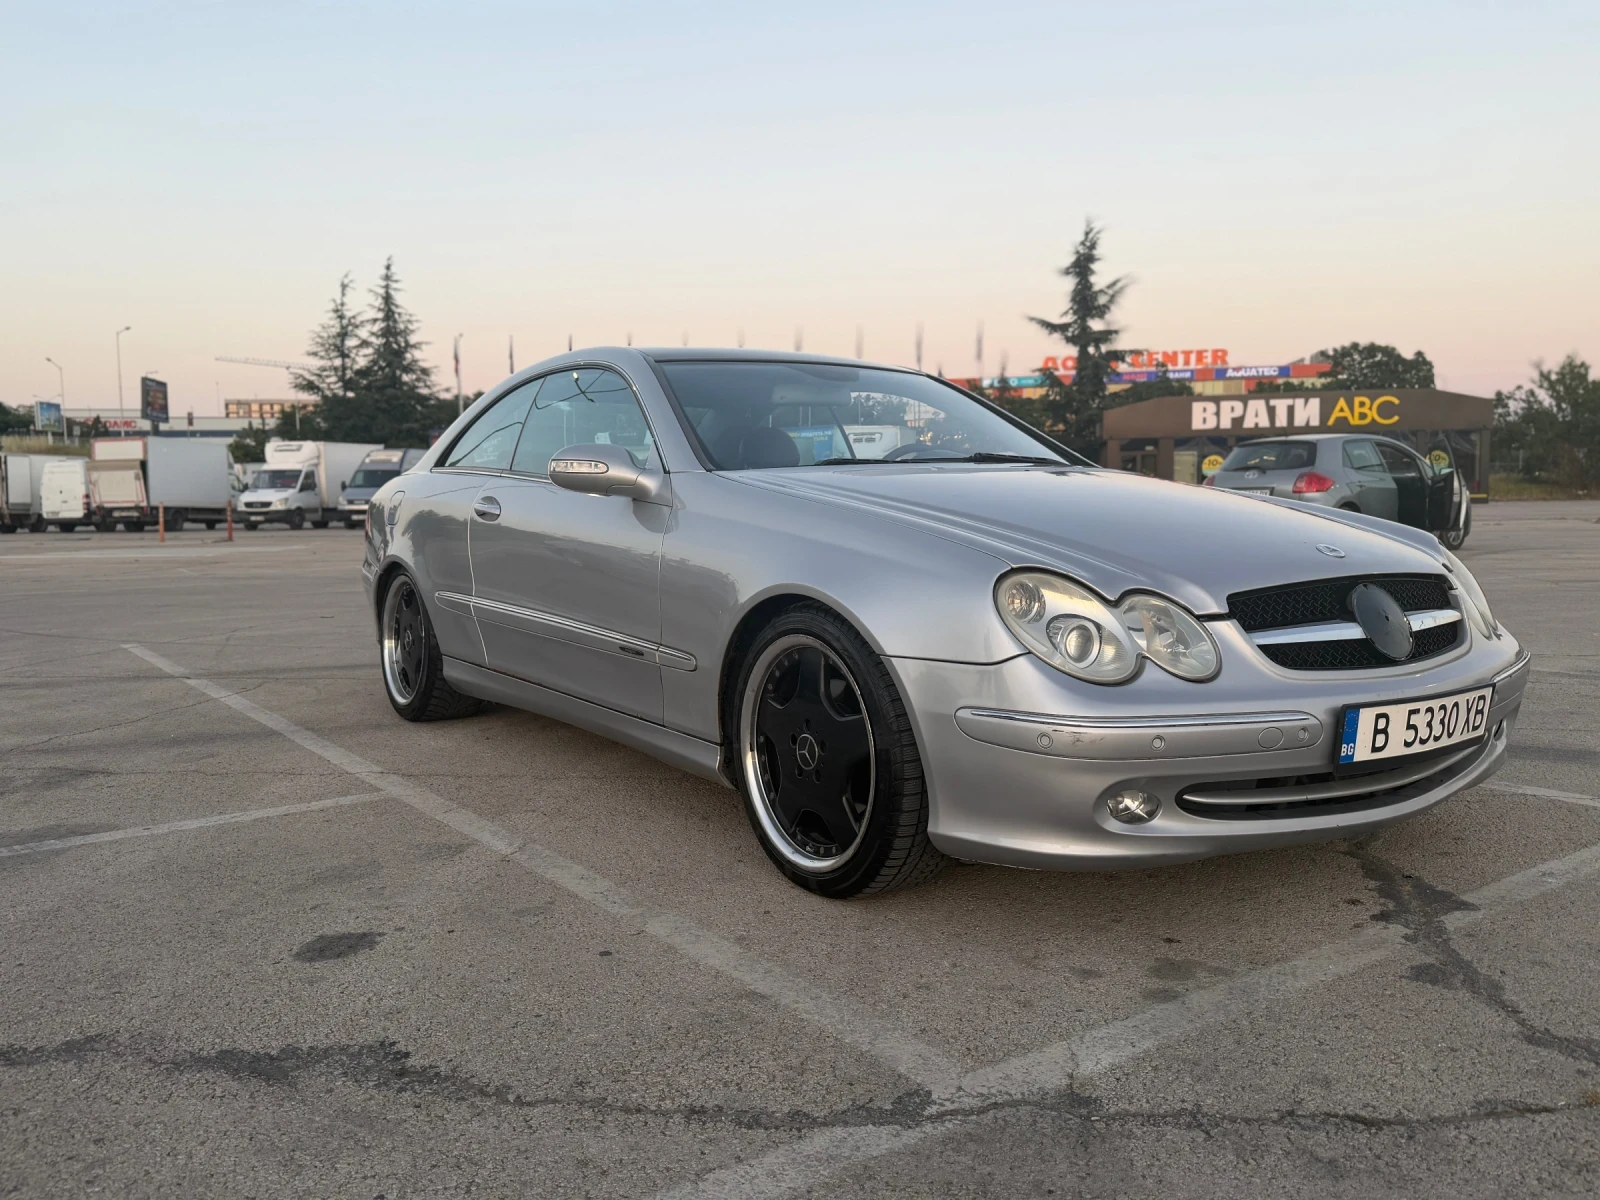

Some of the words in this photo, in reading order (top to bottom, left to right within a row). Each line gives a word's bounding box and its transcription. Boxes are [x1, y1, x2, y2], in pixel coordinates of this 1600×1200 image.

[1131, 349, 1227, 367] CENTER
[1226, 367, 1279, 377] AQUATEC
[1192, 398, 1320, 430] ВРАТИ
[1327, 396, 1399, 426] ABC
[1371, 712, 1390, 753] B
[1403, 701, 1459, 748] 5330
[1460, 694, 1486, 736] XB
[1341, 744, 1354, 756] BG
